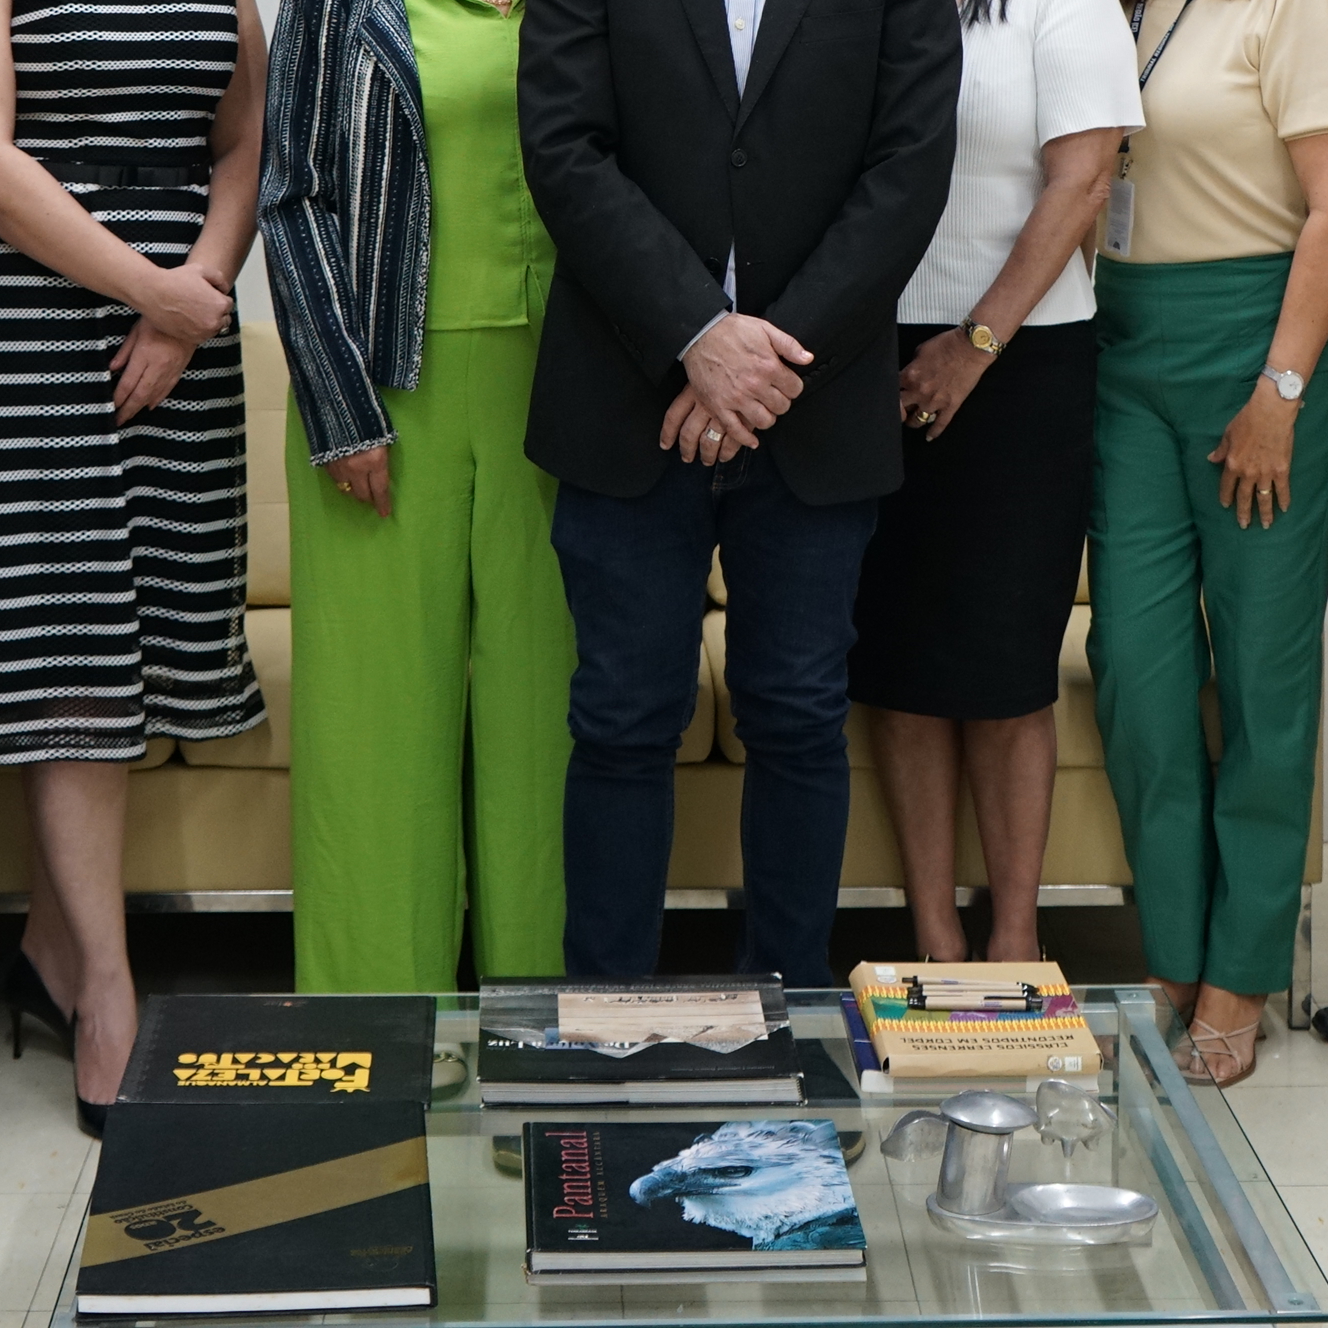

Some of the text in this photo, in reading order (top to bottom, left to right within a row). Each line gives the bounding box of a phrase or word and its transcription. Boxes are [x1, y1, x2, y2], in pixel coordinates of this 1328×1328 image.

[982, 1034, 1074, 1042] RECONTADOS
[997, 1042, 1068, 1050] CLÁSSICOS
[177, 1052, 373, 1069] MARACATUS
[173, 1068, 370, 1089] FORTALEZA
[545, 1131, 594, 1219] Pantanal
[114, 1204, 194, 1224] Constituição
[124, 1209, 217, 1241] 20
[143, 1227, 226, 1252] especial
